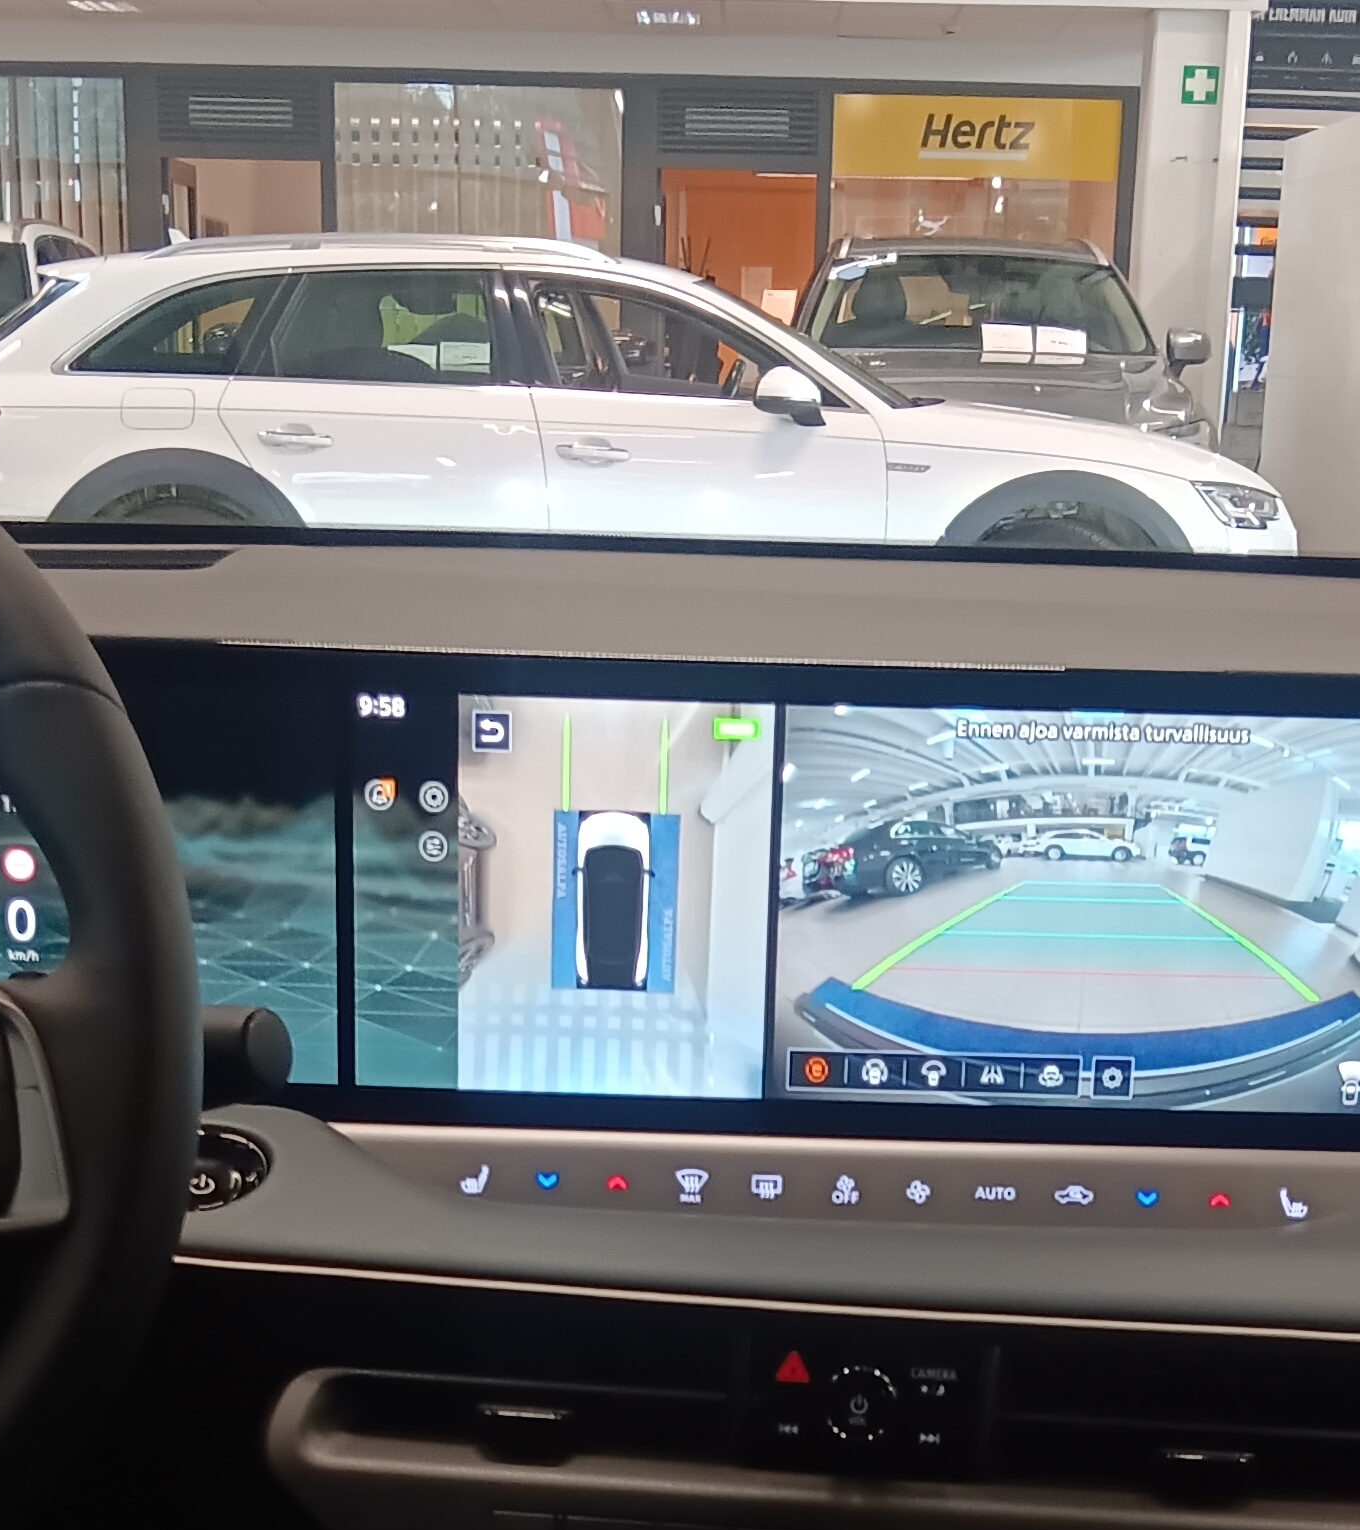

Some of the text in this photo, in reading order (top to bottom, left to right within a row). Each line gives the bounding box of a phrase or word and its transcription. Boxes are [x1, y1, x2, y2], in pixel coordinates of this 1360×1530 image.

[921, 113, 1035, 150] Hertz
[359, 695, 405, 718] 9:58
[956, 719, 1251, 744] Ennen ajoa varmista turvallisuus
[6, 898, 37, 942] 0
[7, 948, 40, 962] km/h
[831, 1190, 859, 1204] OFF
[974, 1186, 1017, 1201] AUTO
[911, 1367, 958, 1381] CAMERA
